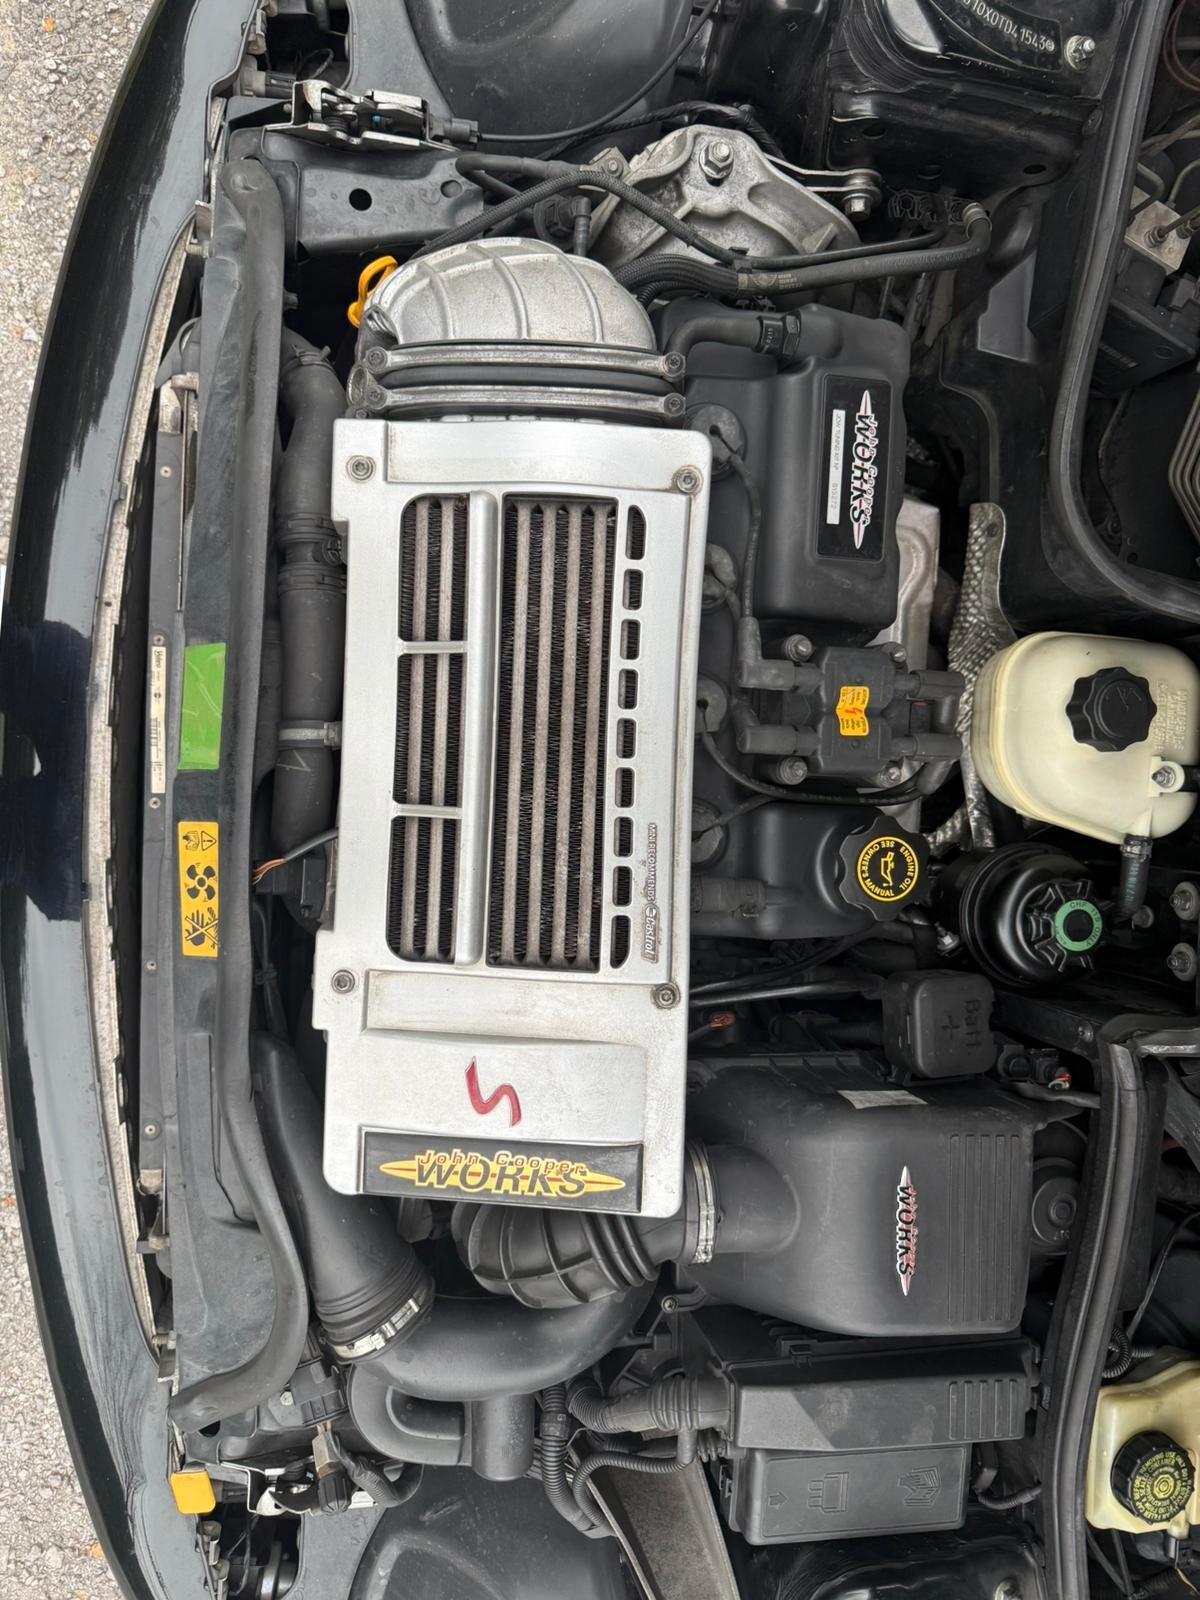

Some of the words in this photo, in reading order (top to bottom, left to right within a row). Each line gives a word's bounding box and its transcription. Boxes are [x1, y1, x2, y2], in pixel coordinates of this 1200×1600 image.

[869, 416, 879, 456] John
[850, 413, 873, 525] WORKS
[864, 465, 878, 525] Cooper
[648, 823, 658, 842] MINI
[881, 840, 895, 848] SEE
[647, 843, 657, 902] RECOMMENDS
[861, 844, 879, 878] OWNER'S
[900, 846, 914, 876] ENGINE
[864, 878, 894, 896] MANUAL
[899, 878, 911, 890] OIL
[645, 917, 656, 954] Castrol
[414, 1154, 588, 1198] WORKS
[419, 1148, 481, 1165] John
[494, 1150, 587, 1174] Cooper
[896, 1185, 914, 1276] WORKS
[1136, 1502, 1145, 1512] CAP
